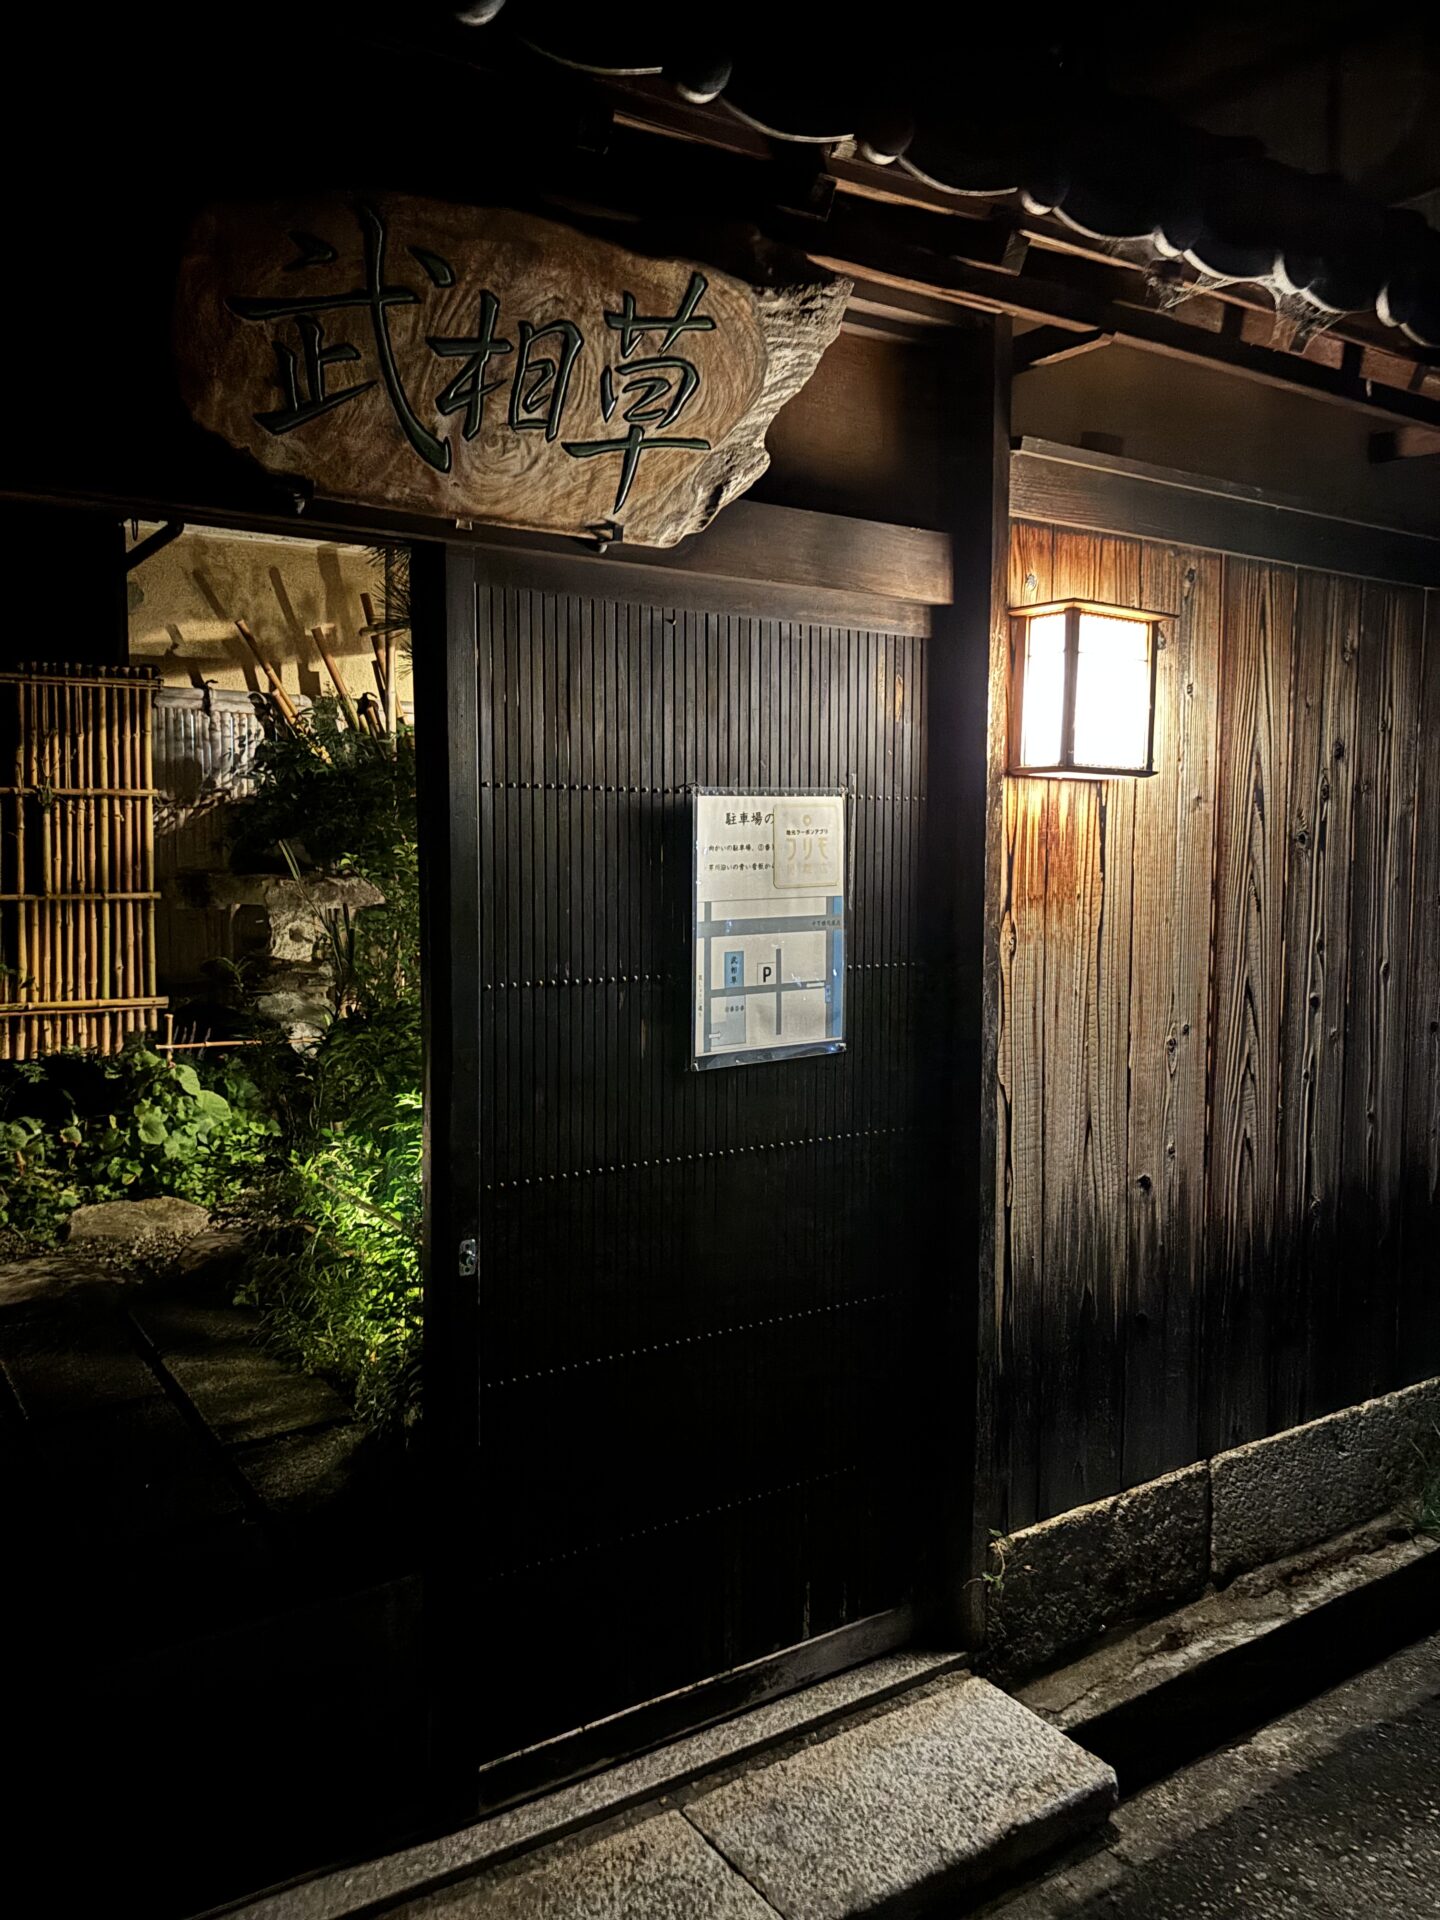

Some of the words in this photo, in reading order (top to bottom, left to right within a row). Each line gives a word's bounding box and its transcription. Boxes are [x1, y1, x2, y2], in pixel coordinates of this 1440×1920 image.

[226, 206, 714, 515] 武相草
[762, 966, 772, 982] P
